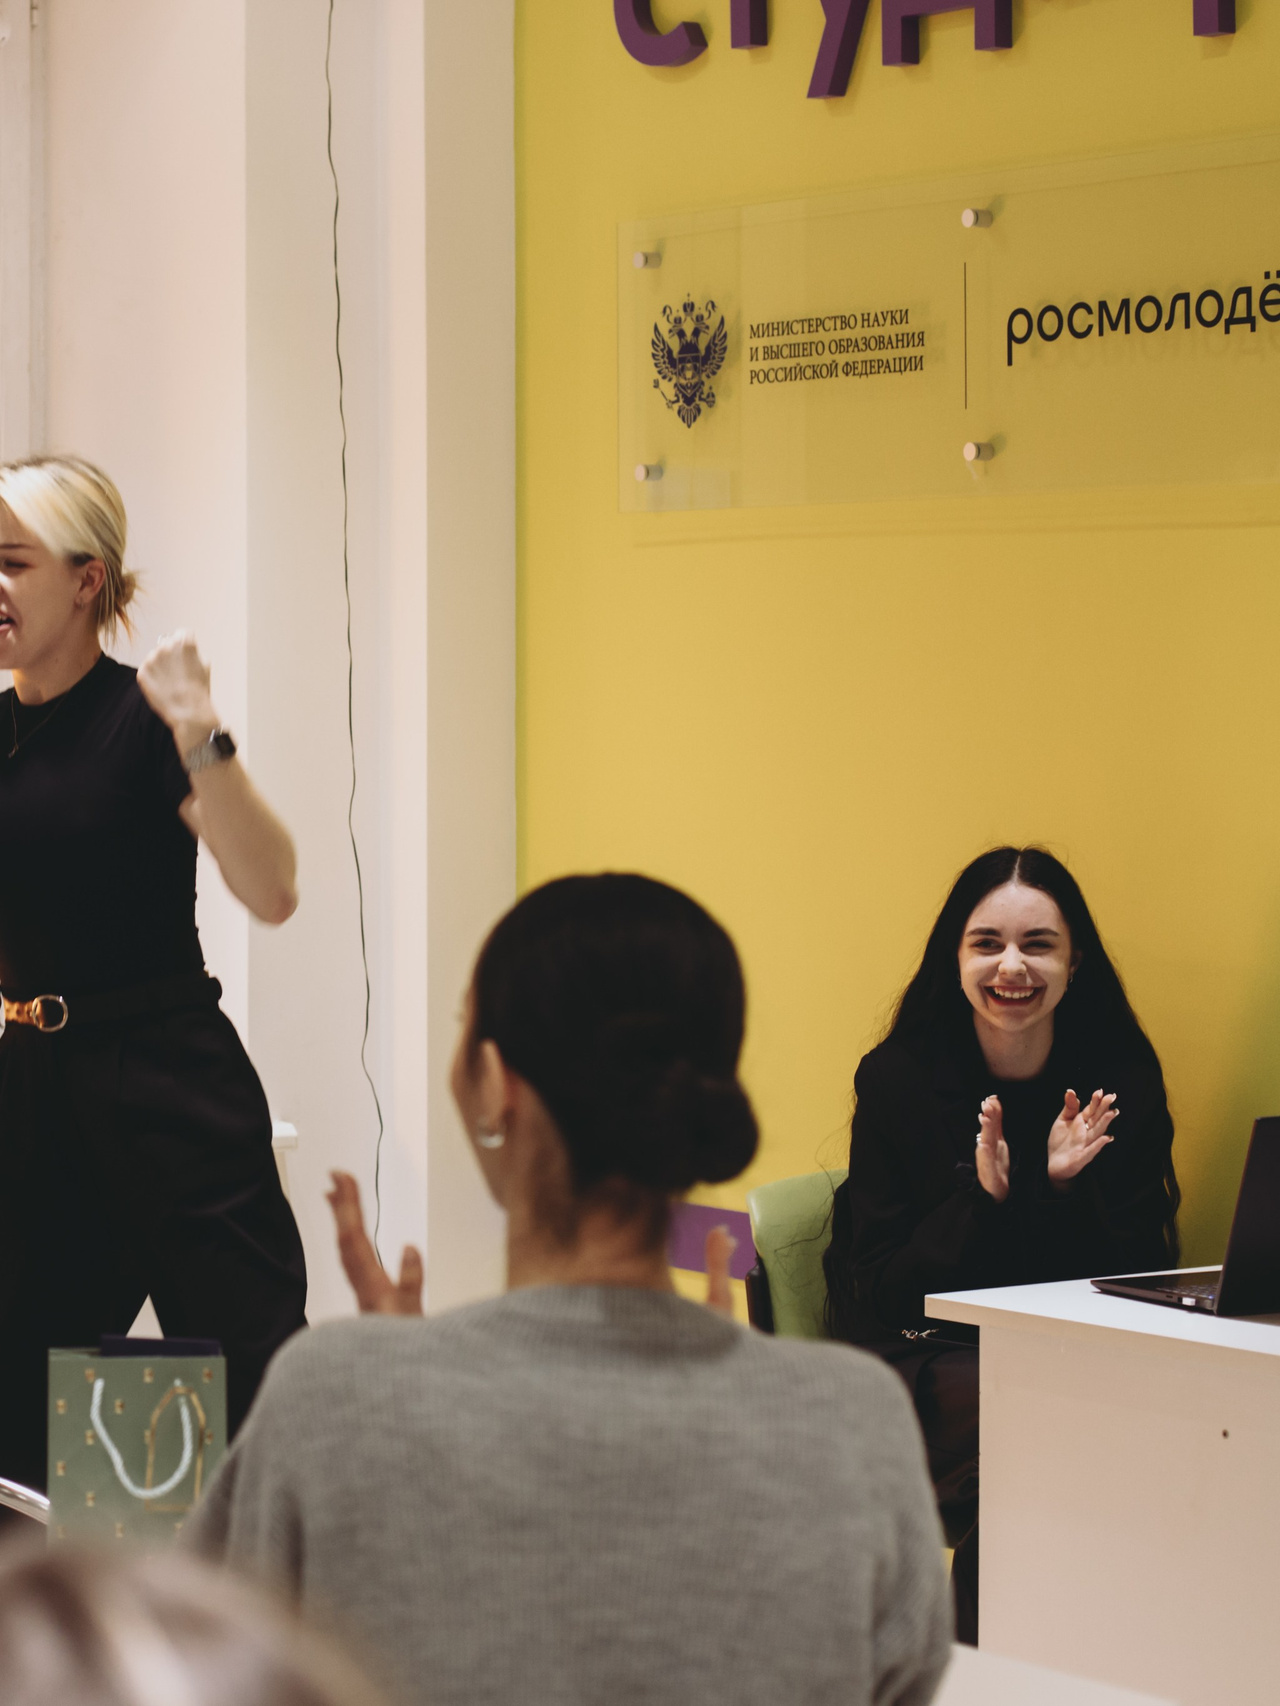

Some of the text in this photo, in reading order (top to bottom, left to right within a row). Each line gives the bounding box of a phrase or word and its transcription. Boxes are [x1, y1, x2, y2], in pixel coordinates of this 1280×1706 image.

[749, 308, 910, 339] МИНИСТЕРСТВО НАУКИ
[749, 331, 926, 362] И ВЫСШЕГО ОБРАЗОВАНИЯ
[749, 355, 925, 385] РОССИЙСКОЙ ФЕДЕРАЦИИ
